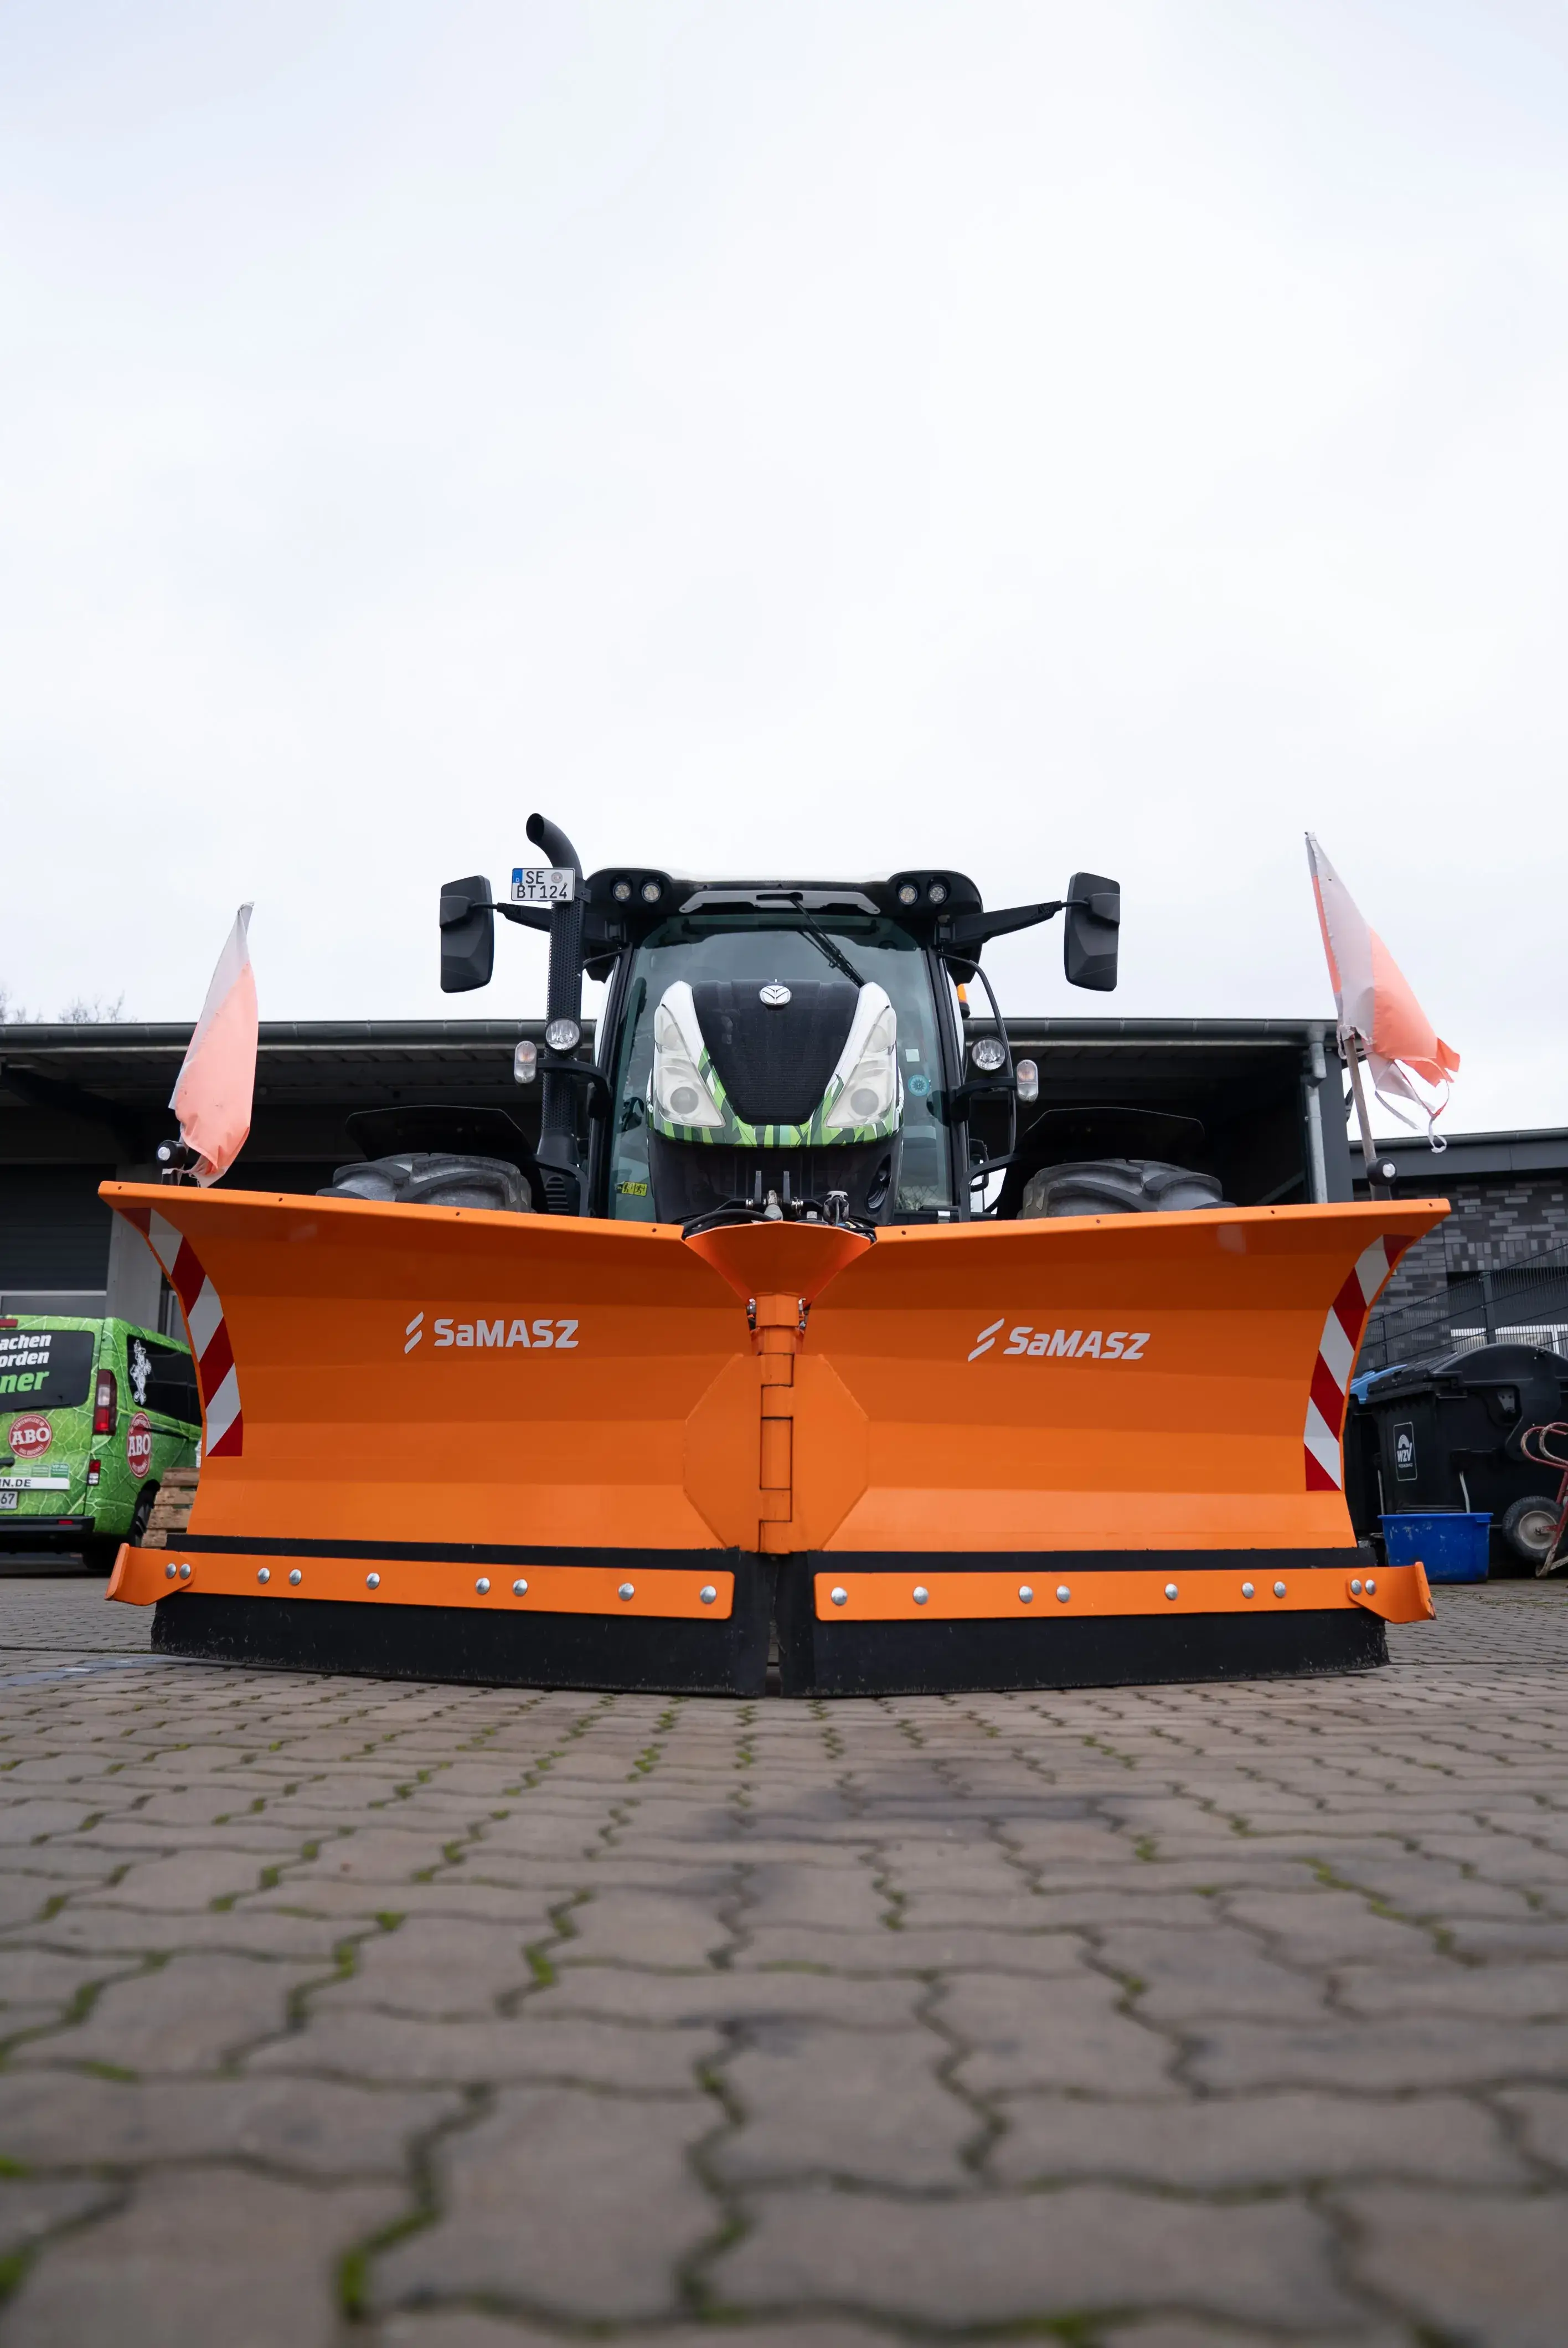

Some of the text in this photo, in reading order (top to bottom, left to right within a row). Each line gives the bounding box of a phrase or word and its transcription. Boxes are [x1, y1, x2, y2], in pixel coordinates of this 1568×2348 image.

[525, 871, 544, 884] SE
[517, 885, 567, 899] BT 124
[434, 1319, 579, 1348] SaMASZ
[1003, 1326, 1151, 1360] SaMASZ
[11, 1428, 50, 1446] ABO
[128, 1434, 151, 1456] ABO
[1397, 1442, 1412, 1462] WZV
[1, 1493, 15, 1505] 67
